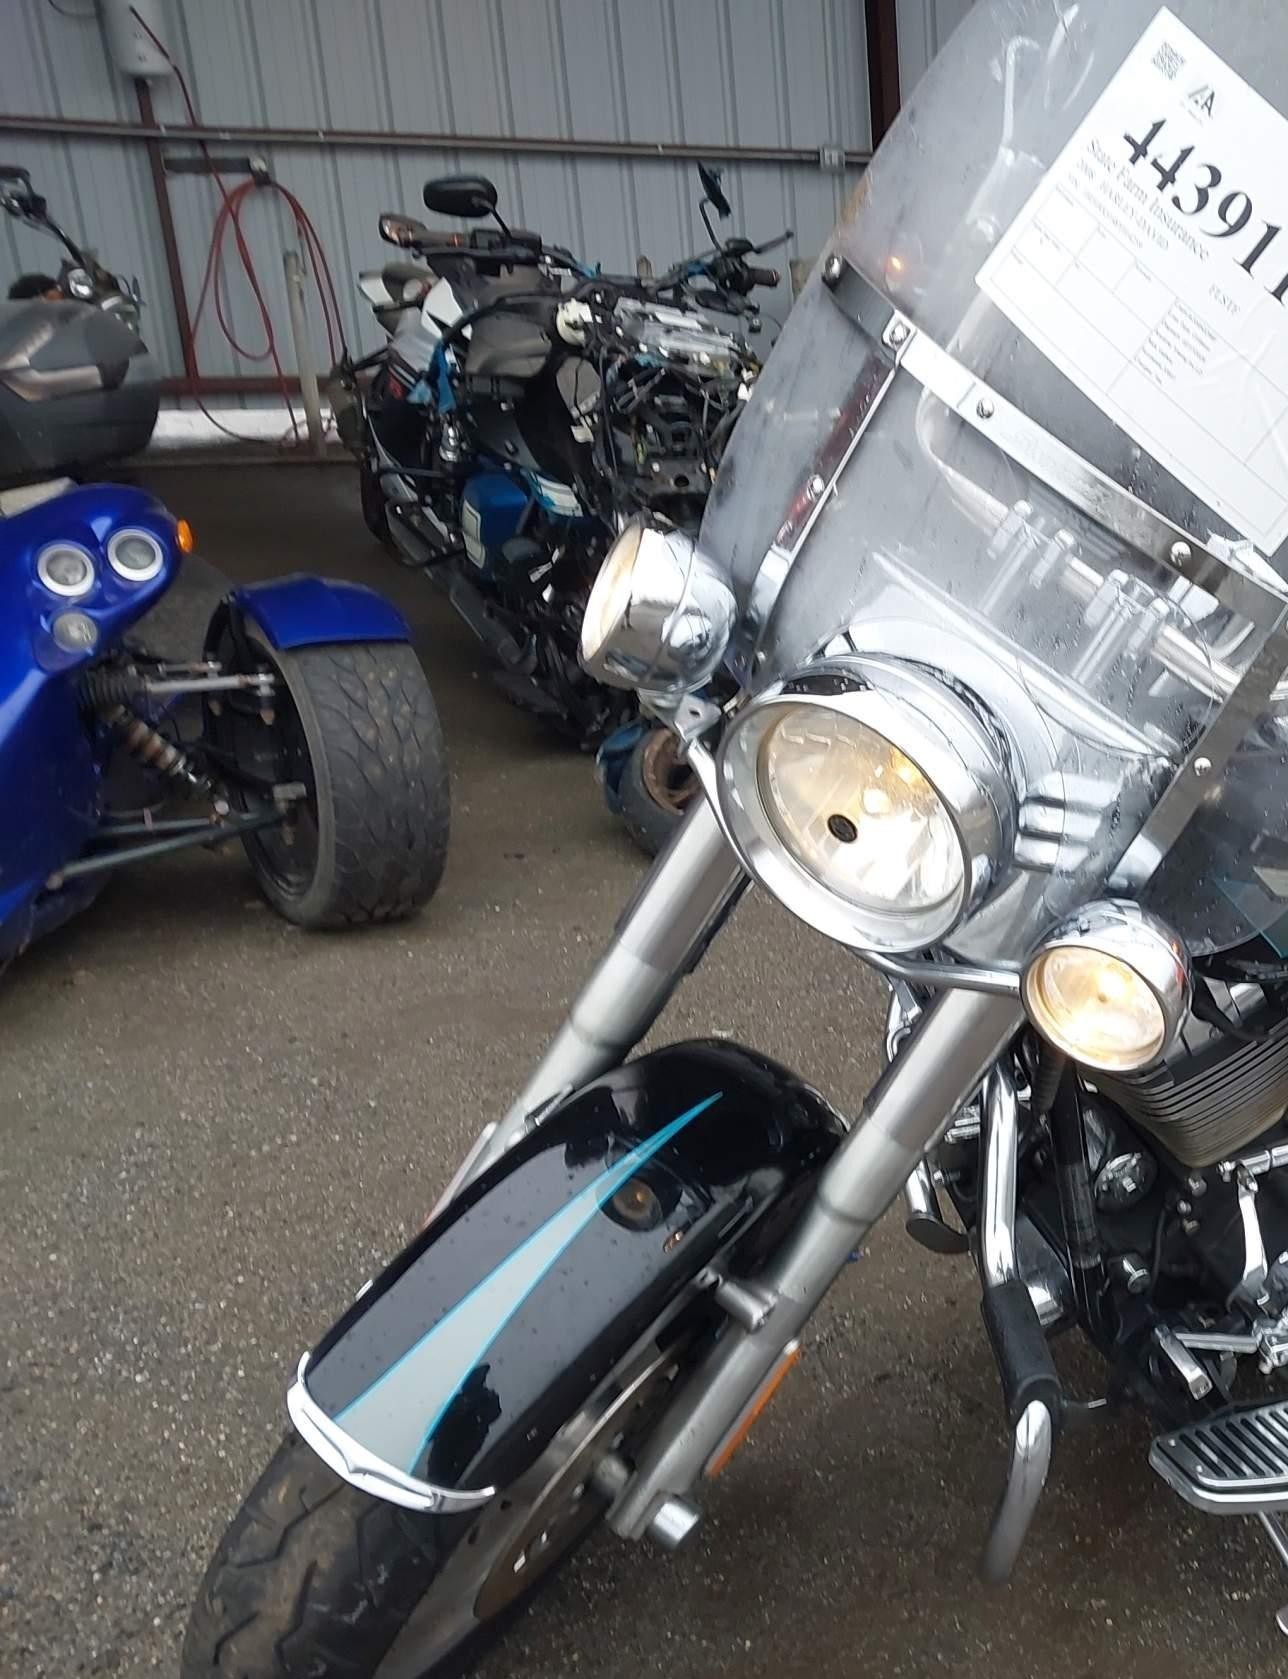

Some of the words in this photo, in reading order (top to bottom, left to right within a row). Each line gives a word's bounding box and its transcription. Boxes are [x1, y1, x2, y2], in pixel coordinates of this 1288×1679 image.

[1086, 138, 1116, 173] State
[1117, 165, 1148, 205] Farm
[1149, 196, 1210, 262] Insurance
